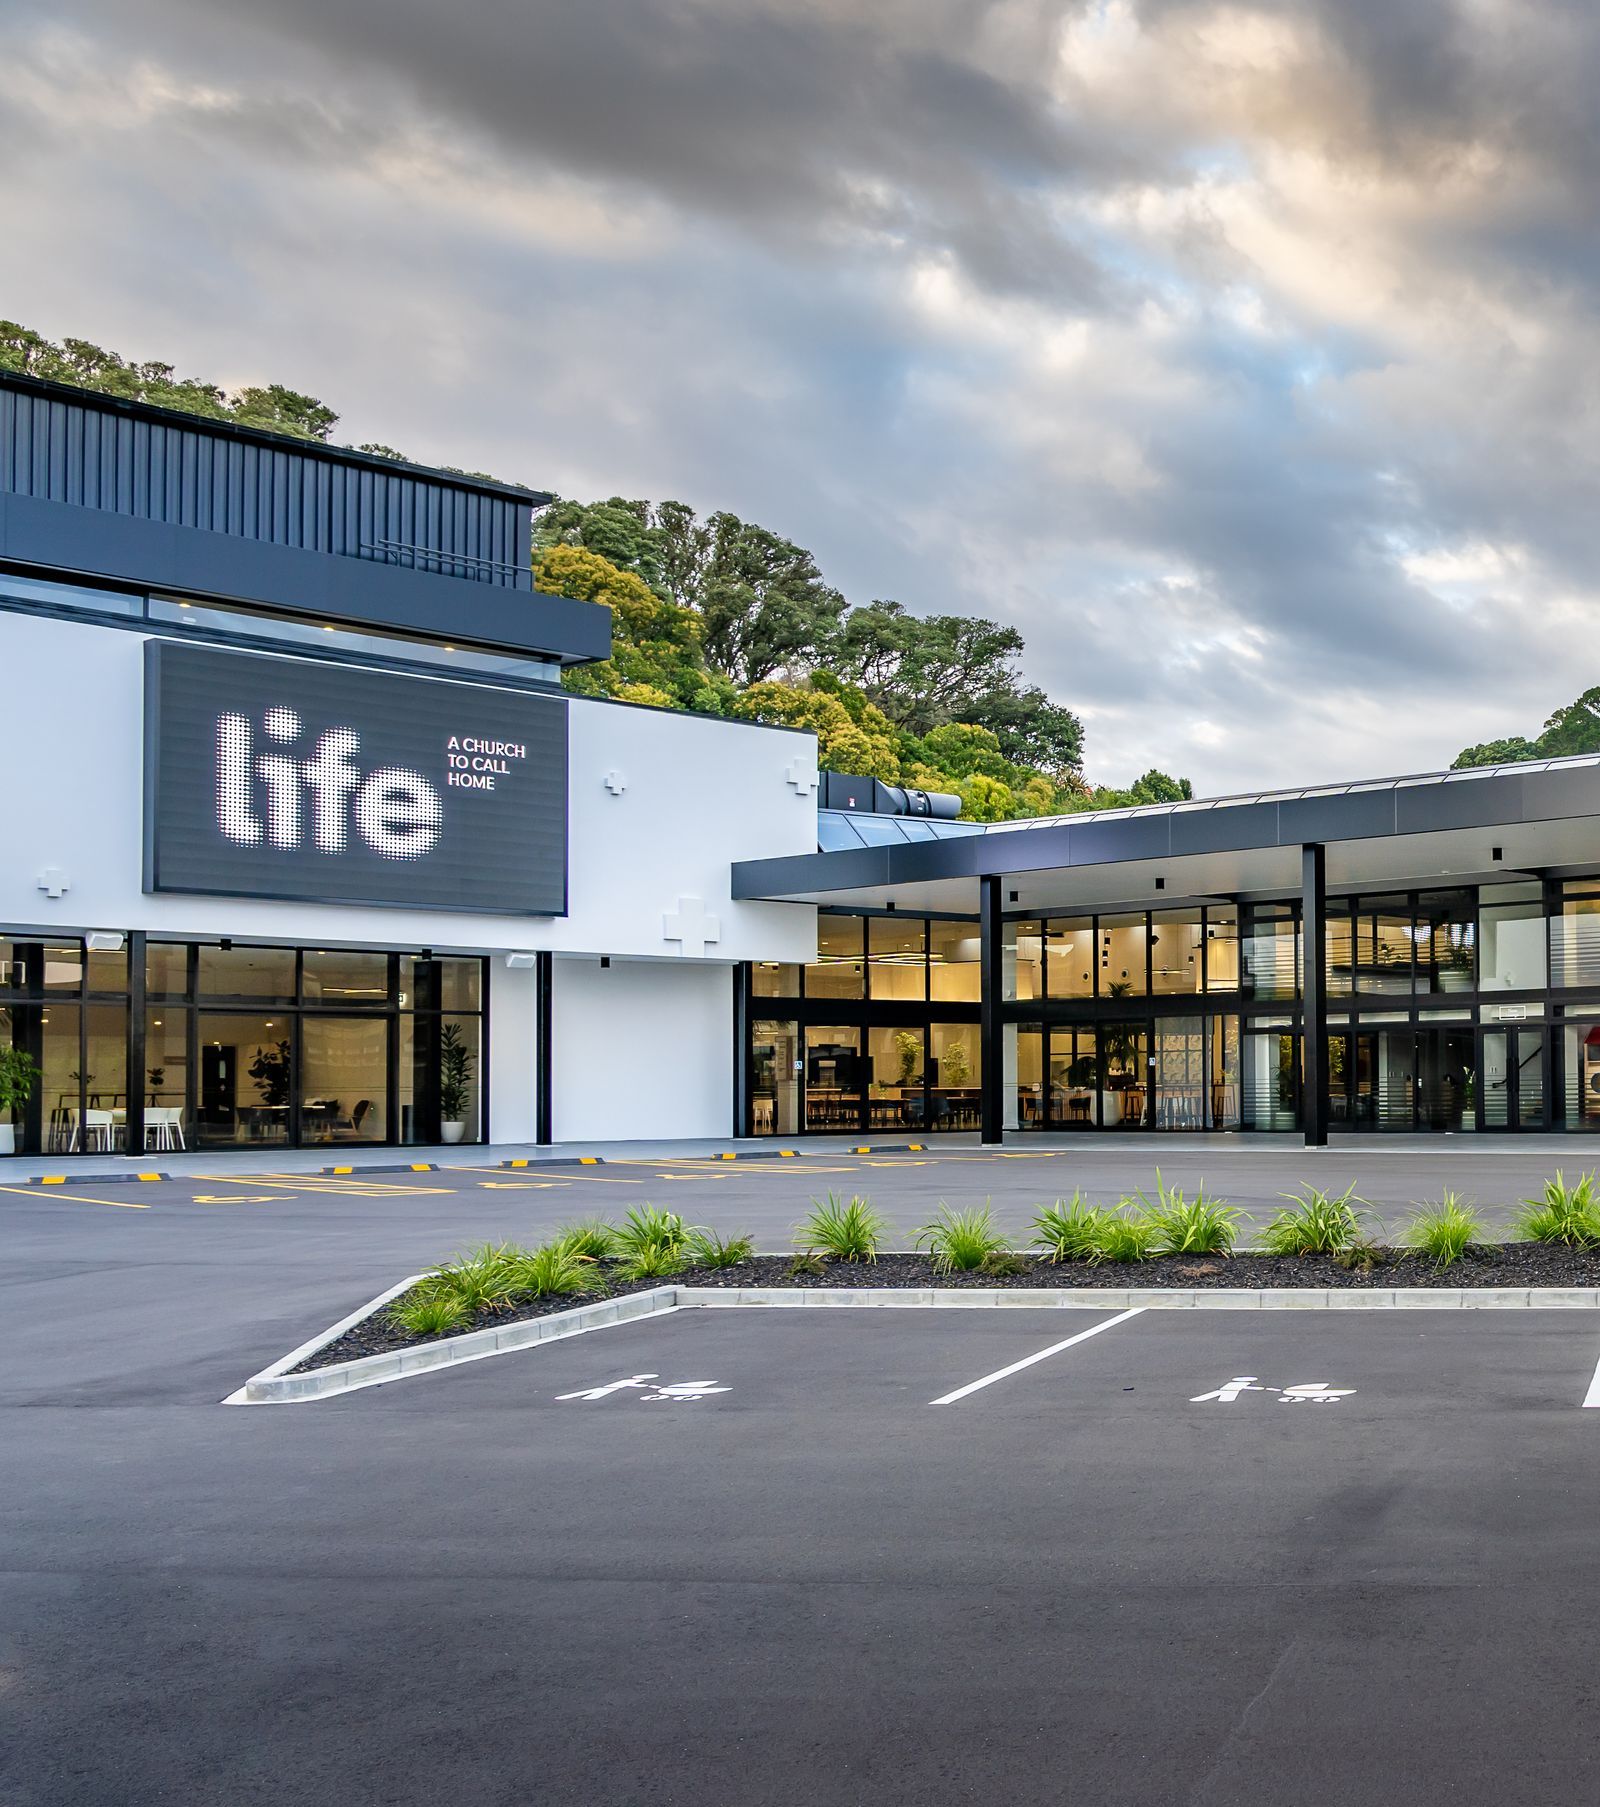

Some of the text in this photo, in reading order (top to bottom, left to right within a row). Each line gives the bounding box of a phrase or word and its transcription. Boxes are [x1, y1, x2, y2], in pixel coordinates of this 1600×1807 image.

[448, 737, 526, 758] A CHURCH
[448, 754, 511, 775] TO CALL
[216, 705, 443, 861] life
[448, 772, 495, 790] HOME
